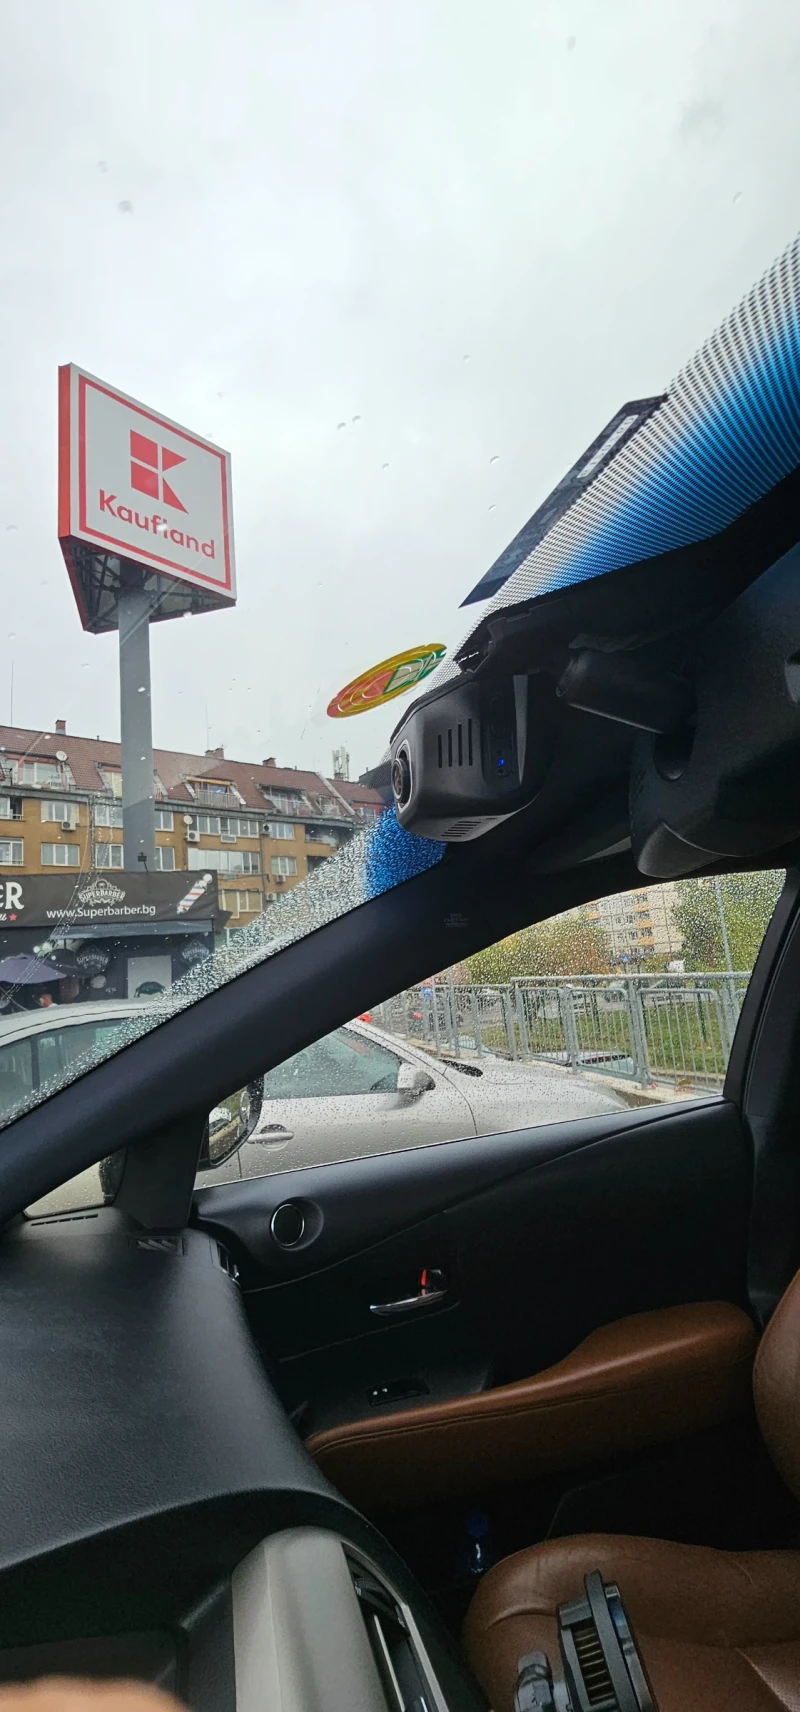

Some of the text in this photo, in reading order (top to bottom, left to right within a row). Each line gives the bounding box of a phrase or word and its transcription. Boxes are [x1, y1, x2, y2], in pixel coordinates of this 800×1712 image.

[98, 488, 216, 559] Kaufland
[0, 881, 25, 910] R
[46, 904, 156, 919] www.Superbarber.bg
